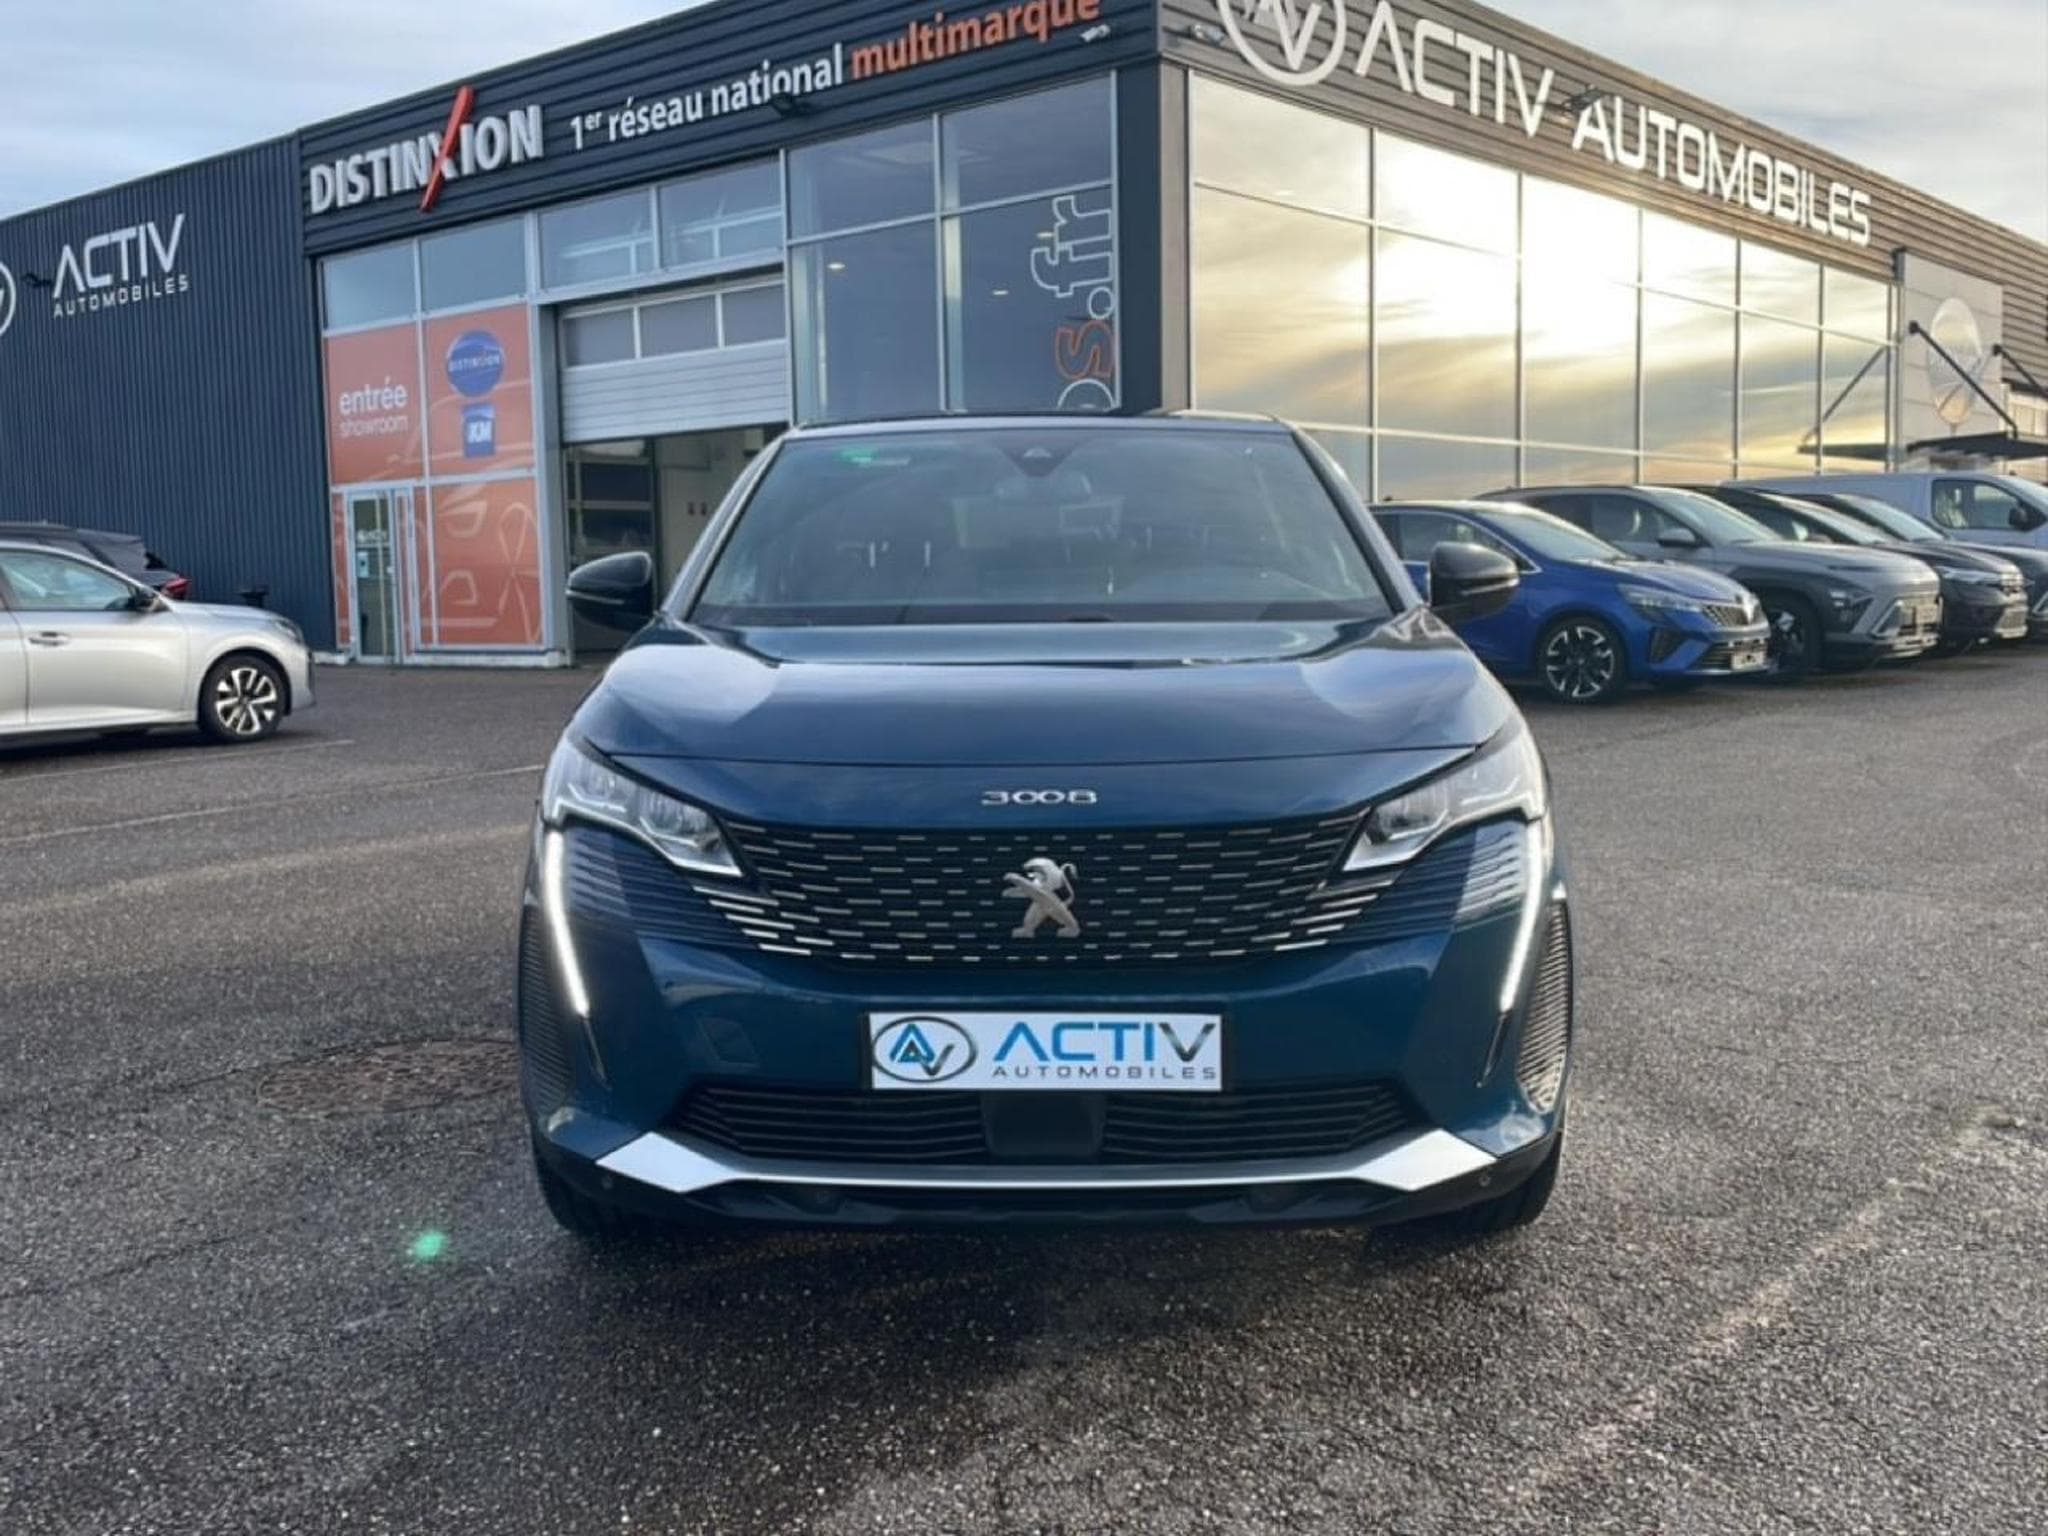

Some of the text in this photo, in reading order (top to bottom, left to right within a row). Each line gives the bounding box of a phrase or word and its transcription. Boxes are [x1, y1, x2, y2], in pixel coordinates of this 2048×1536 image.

[609, 96, 704, 142] réseau
[711, 42, 843, 116] national
[852, 0, 1100, 80] multimarque
[1355, 0, 1871, 247] ACTIV AUTOMOBILES
[53, 213, 186, 299] ACTIV
[53, 274, 189, 319] AUTOMOBILES
[339, 375, 408, 416] entrée
[339, 415, 408, 438] showroom
[981, 790, 1097, 806] 3008
[993, 1021, 1216, 1063] ACTIV
[992, 1065, 1216, 1080] AUTOMOBILES
